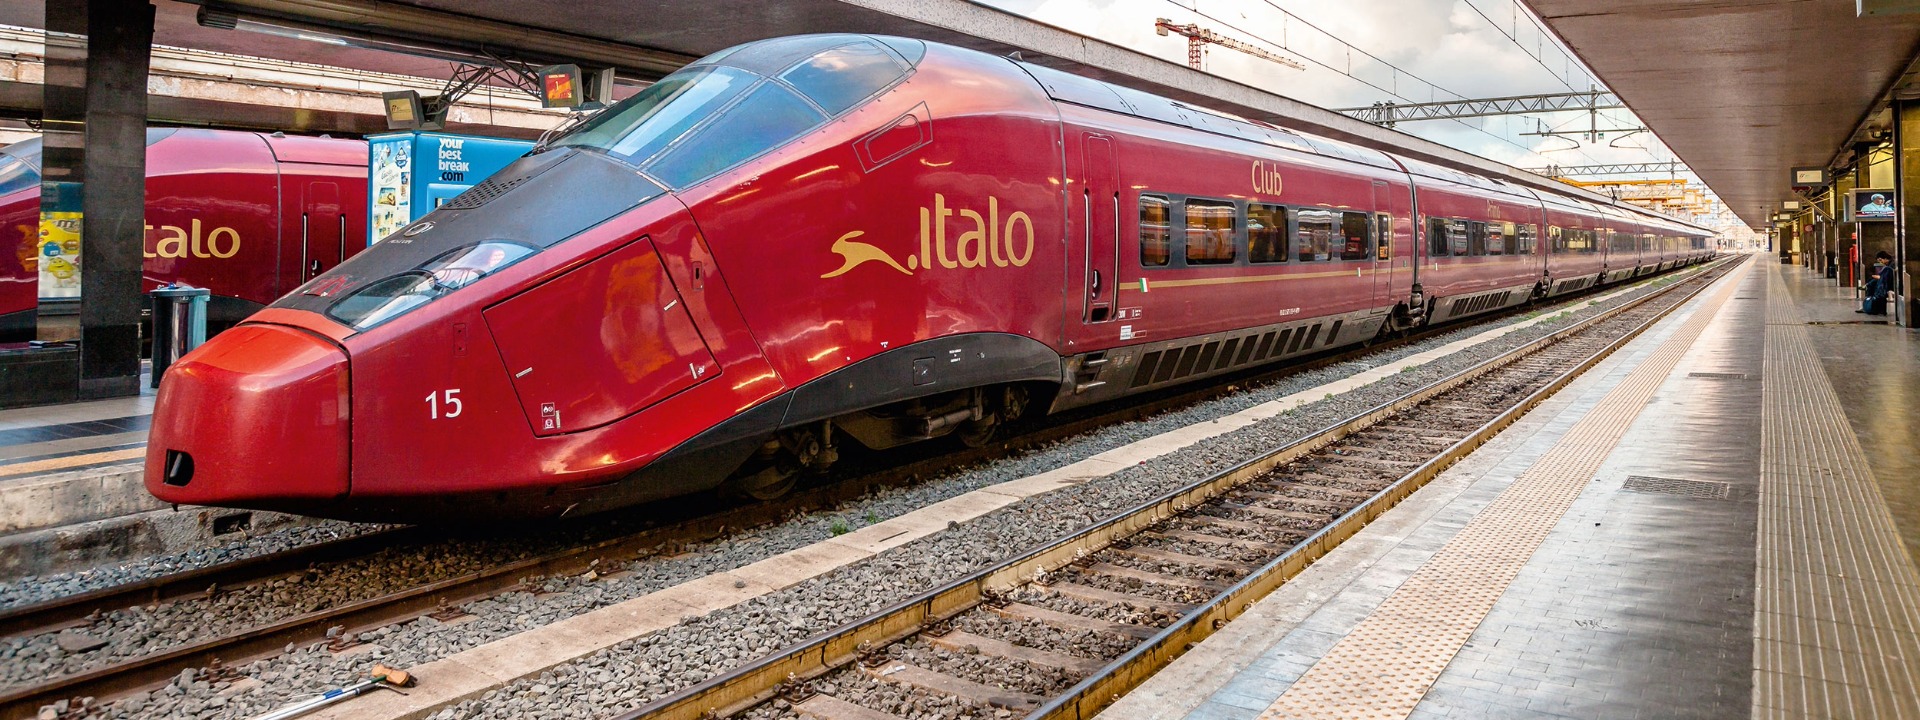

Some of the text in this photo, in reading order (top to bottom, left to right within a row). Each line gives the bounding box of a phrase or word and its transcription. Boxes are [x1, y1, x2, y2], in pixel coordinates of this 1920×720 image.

[439, 138, 464, 149] your
[439, 148, 461, 160] best
[439, 160, 470, 172] break
[439, 171, 464, 181] .com
[1251, 160, 1282, 196] Club
[425, 389, 462, 419] 15
